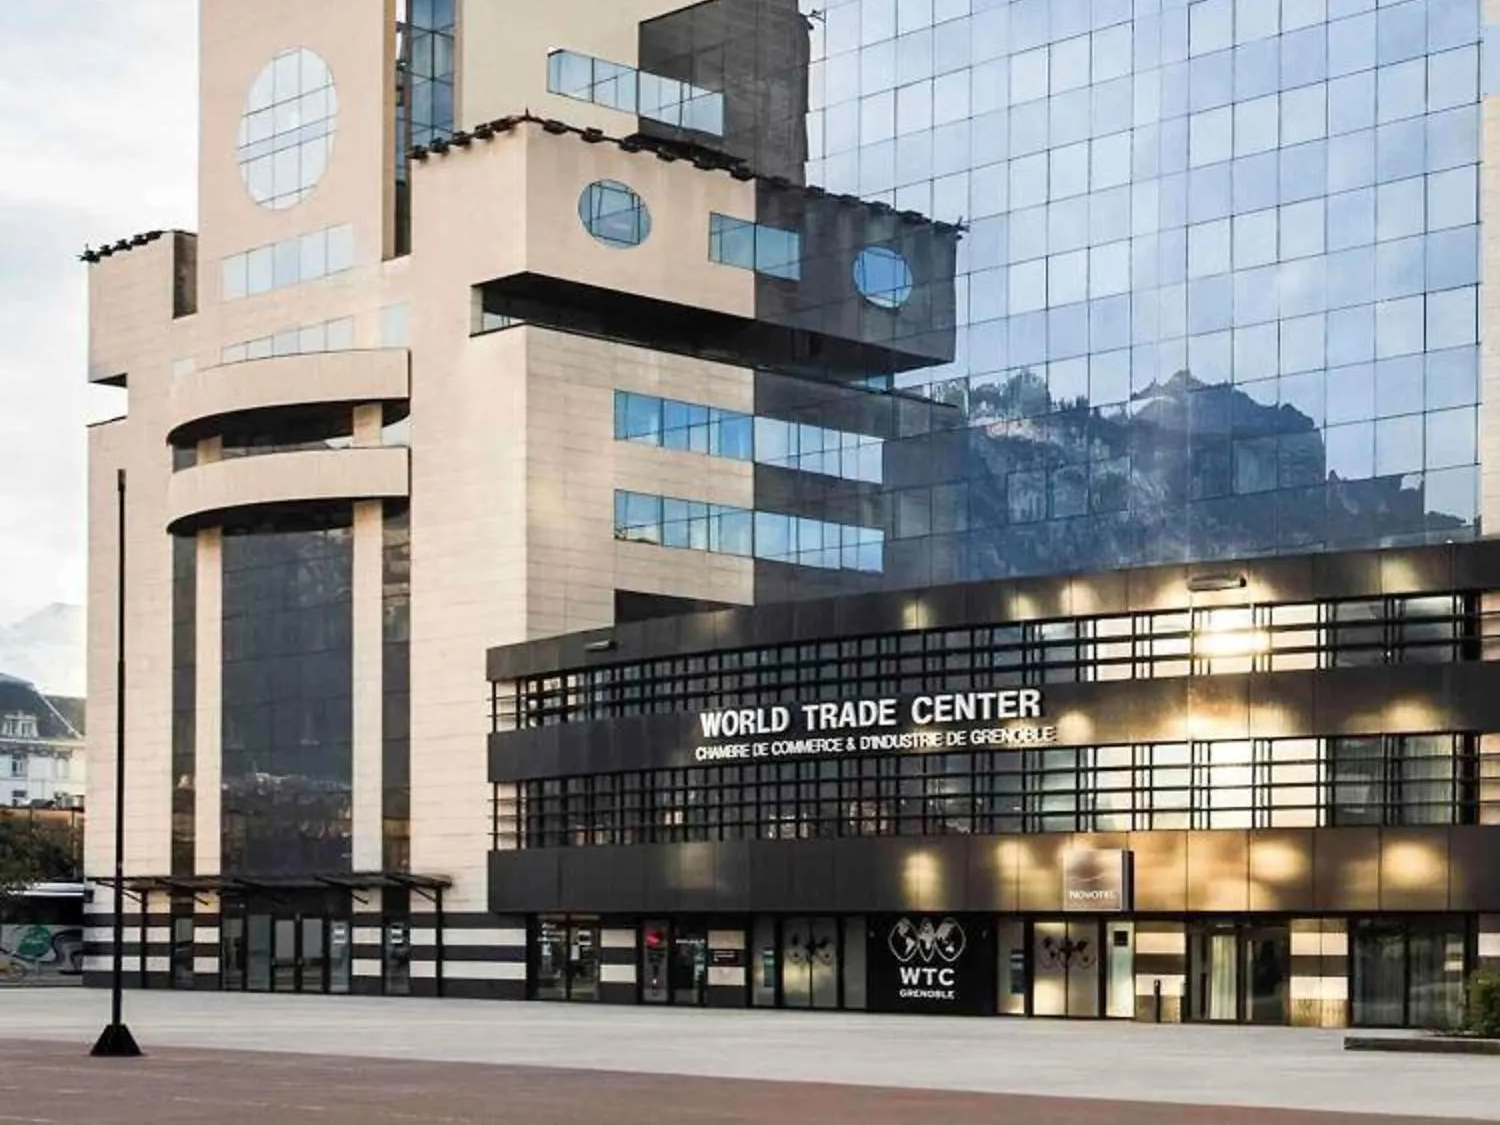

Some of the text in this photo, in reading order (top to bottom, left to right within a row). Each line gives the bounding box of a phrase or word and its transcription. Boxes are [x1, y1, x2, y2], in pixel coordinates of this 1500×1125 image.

[700, 688, 1041, 737] WORLD TRADE CENTER
[695, 726, 1055, 761] CHAMBRE DE COMMERCE & D'INDUSTRIE DE GRENOBLE
[899, 966, 955, 986] WTC
[899, 988, 955, 1000] GRENOBLE
